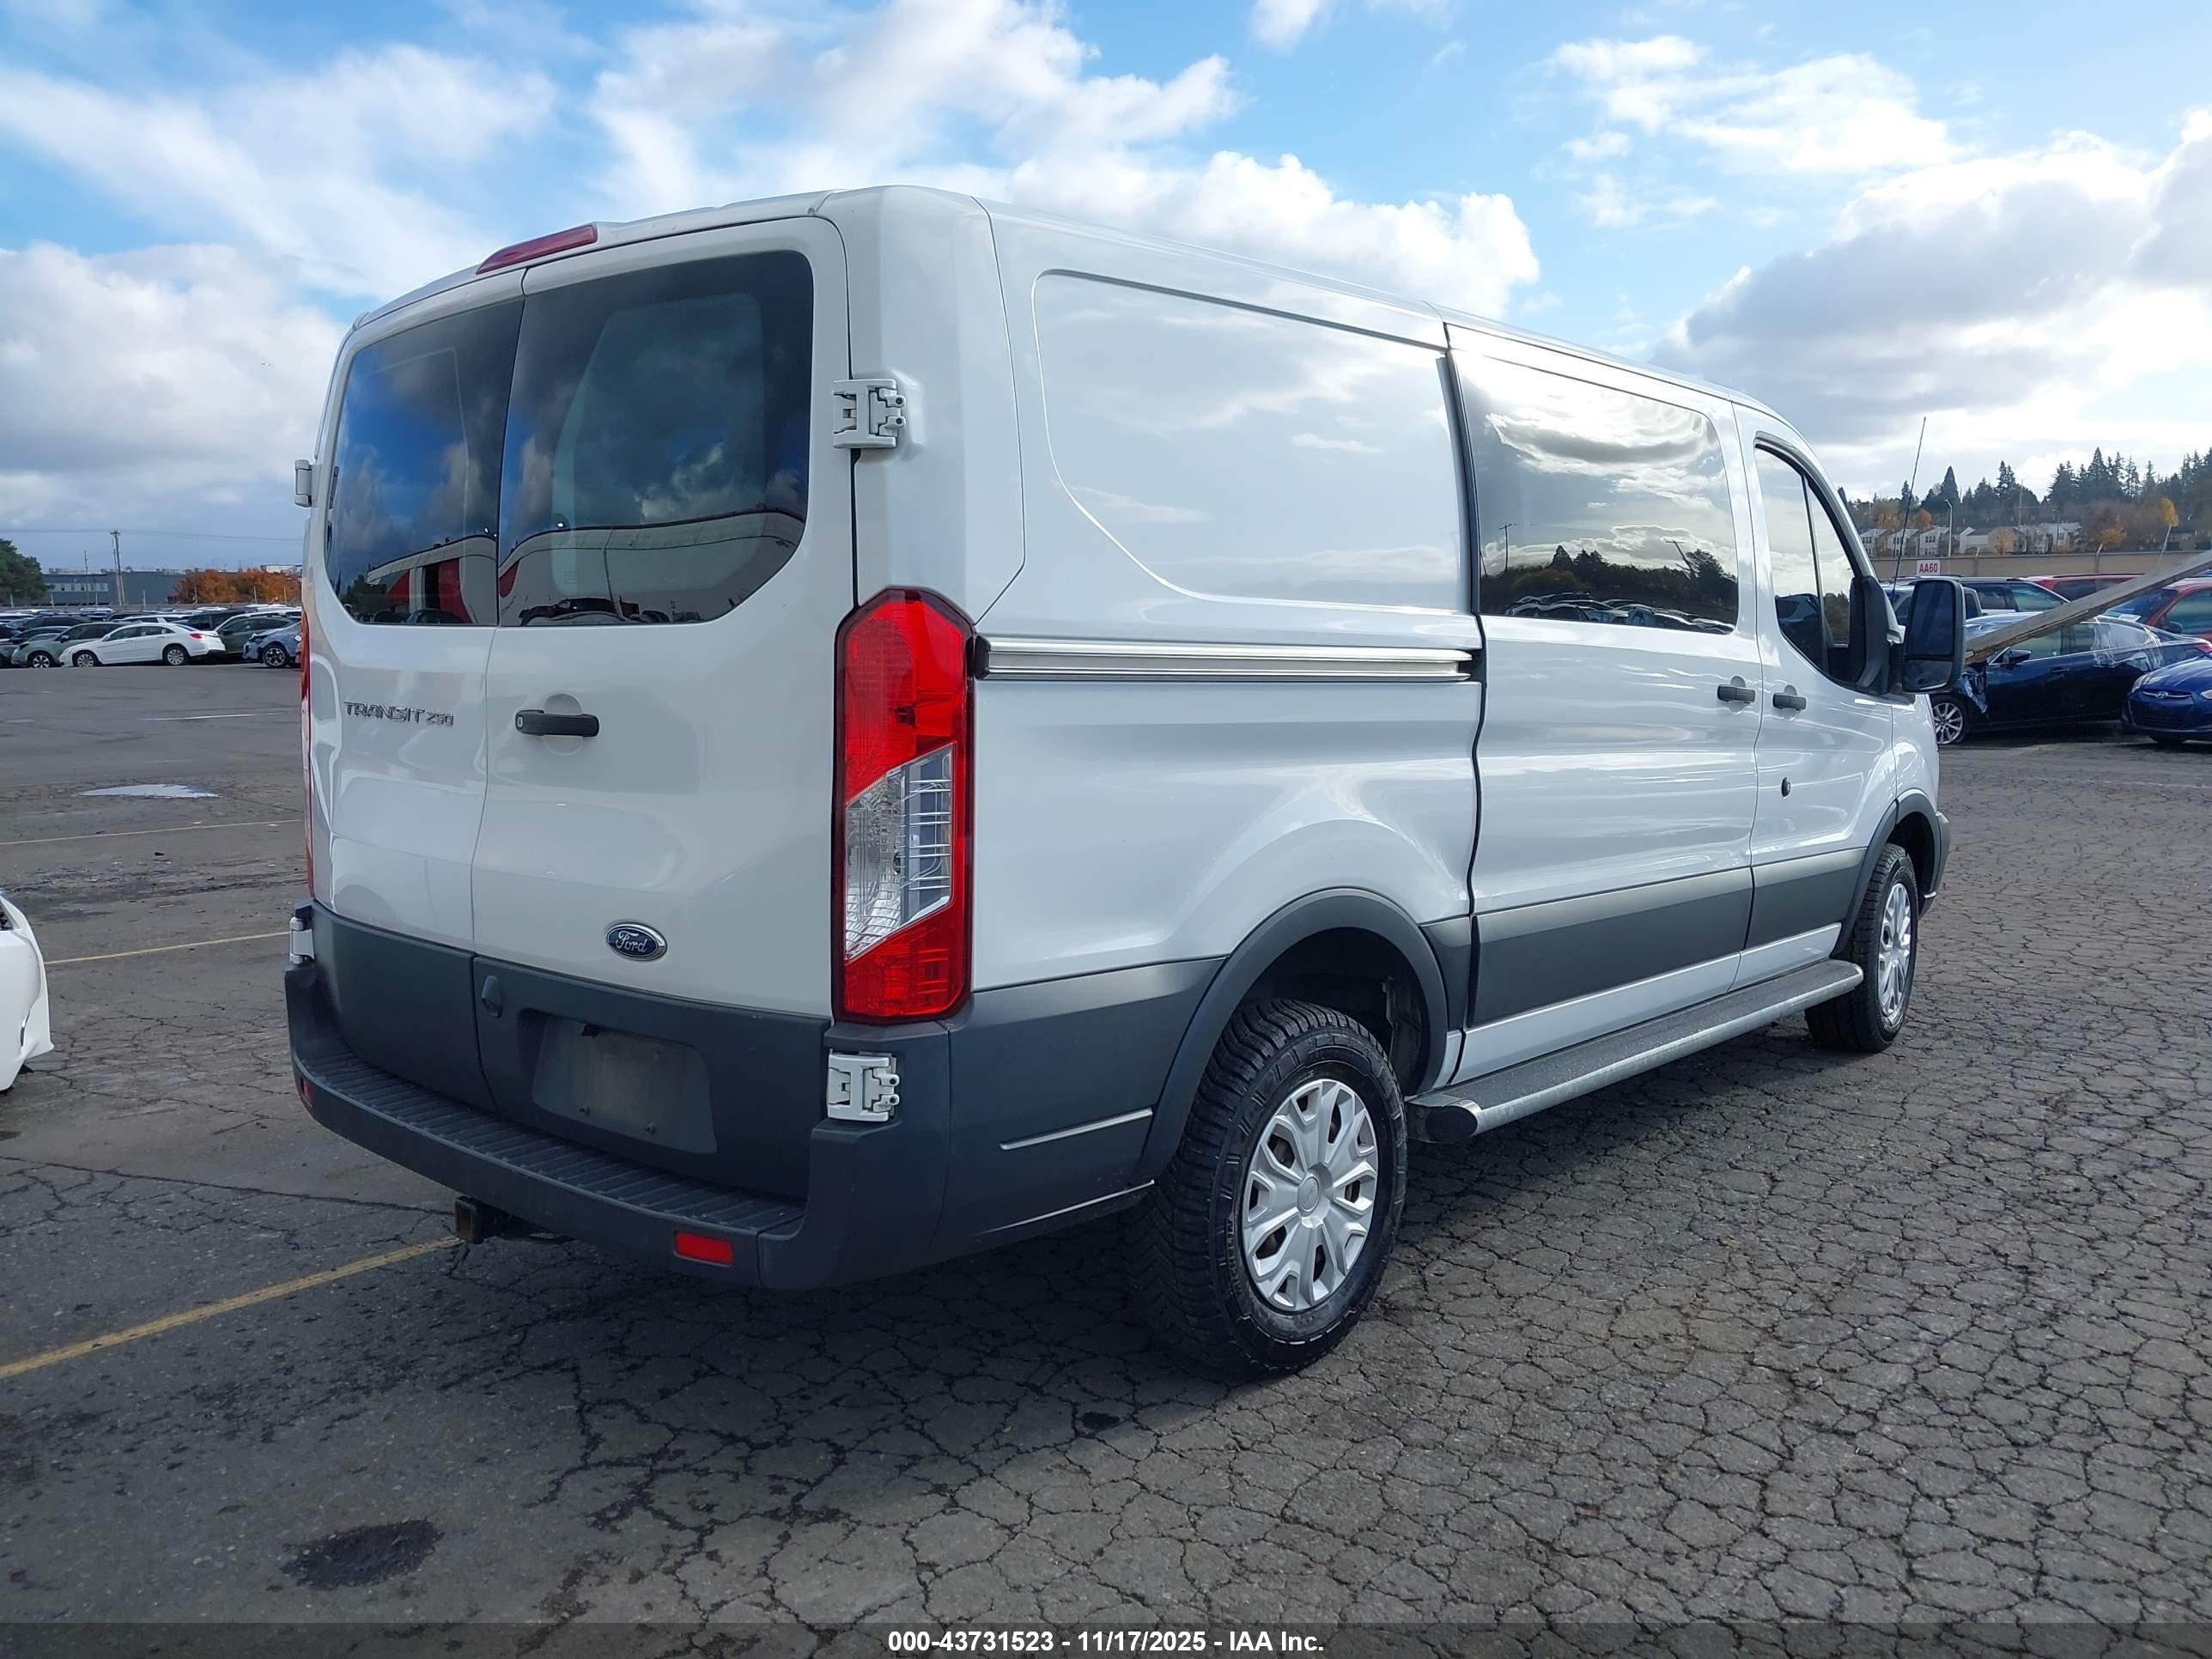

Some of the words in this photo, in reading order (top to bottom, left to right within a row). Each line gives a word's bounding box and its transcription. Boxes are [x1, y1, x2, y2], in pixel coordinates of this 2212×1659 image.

[1919, 562, 1938, 574] AA60
[343, 702, 425, 723] TRANSIT
[426, 712, 454, 726] 250
[615, 930, 648, 953] Ford
